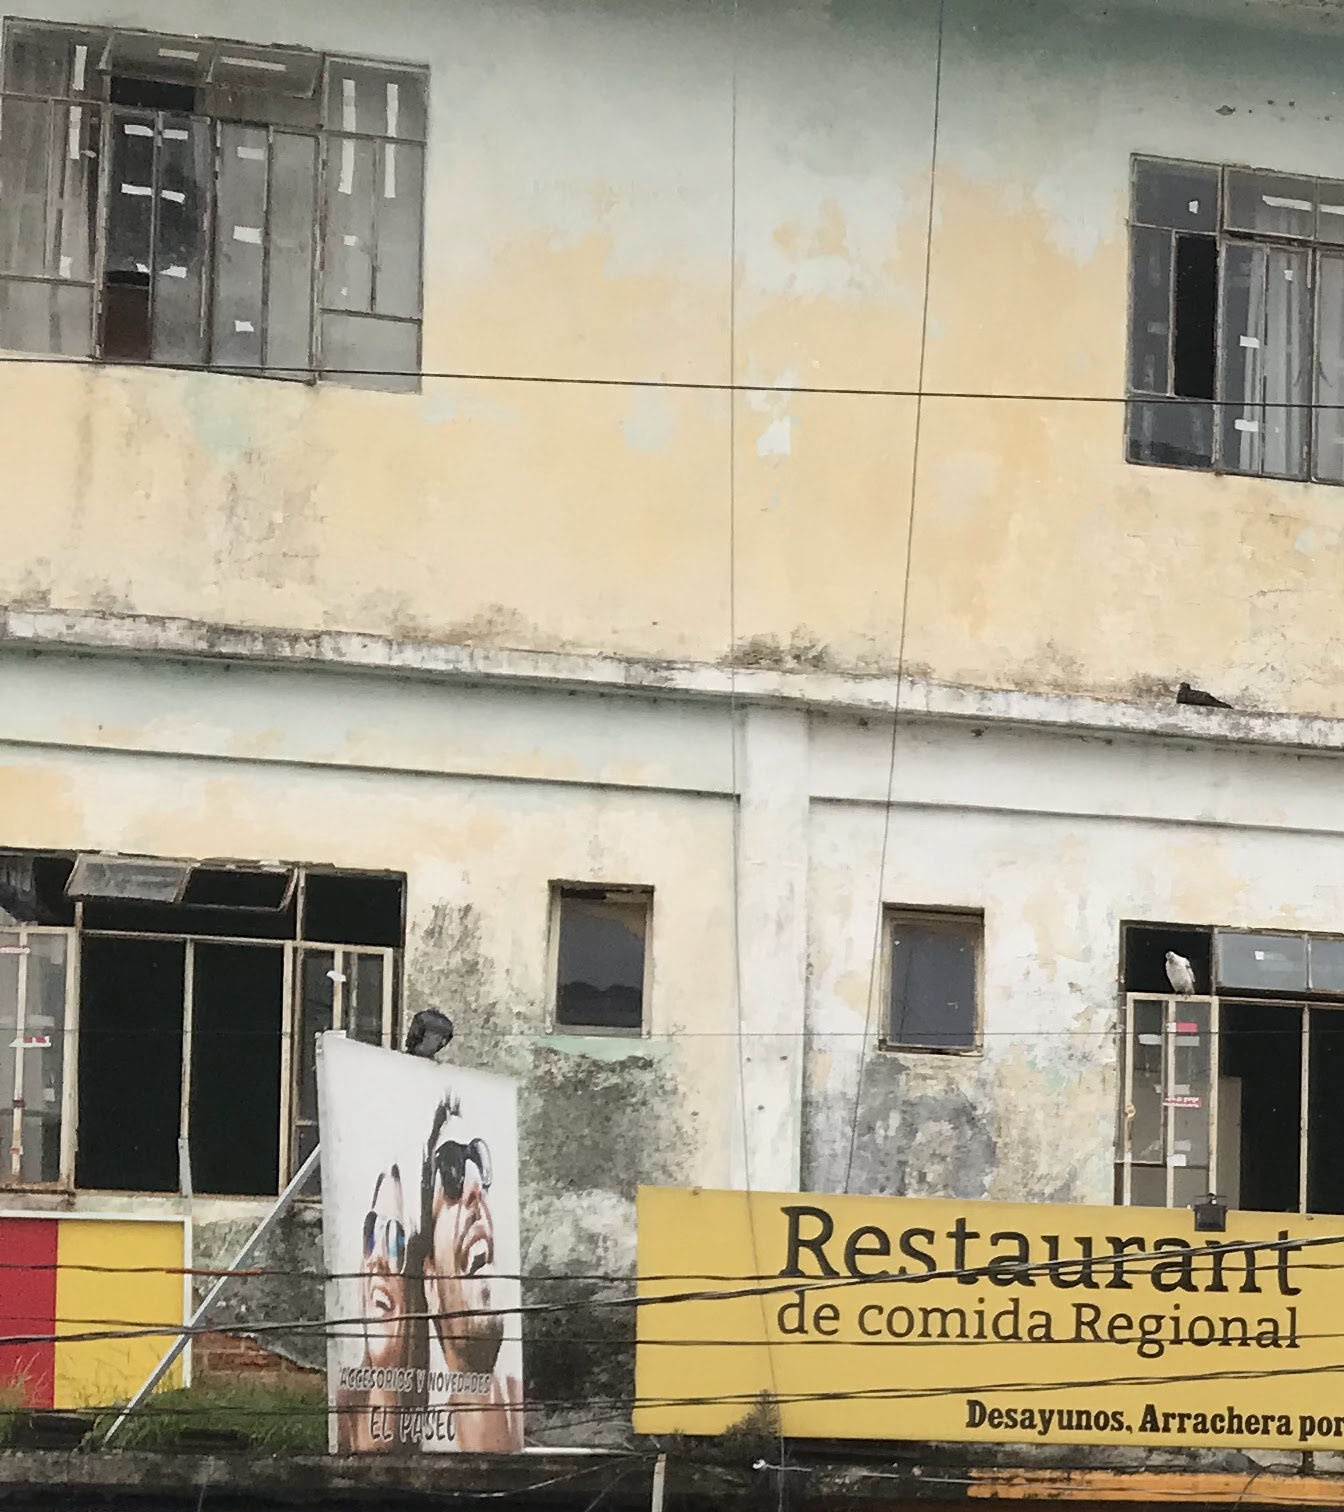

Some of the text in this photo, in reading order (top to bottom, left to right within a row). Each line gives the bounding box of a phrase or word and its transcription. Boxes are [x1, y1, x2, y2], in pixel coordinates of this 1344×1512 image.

[779, 1205, 1303, 1297] Restaurant
[777, 1286, 1301, 1358] de comida Regional
[370, 1406, 393, 1441] EL
[966, 1399, 1134, 1435] Desayunos,
[1138, 1403, 1293, 1436] Arrachera
